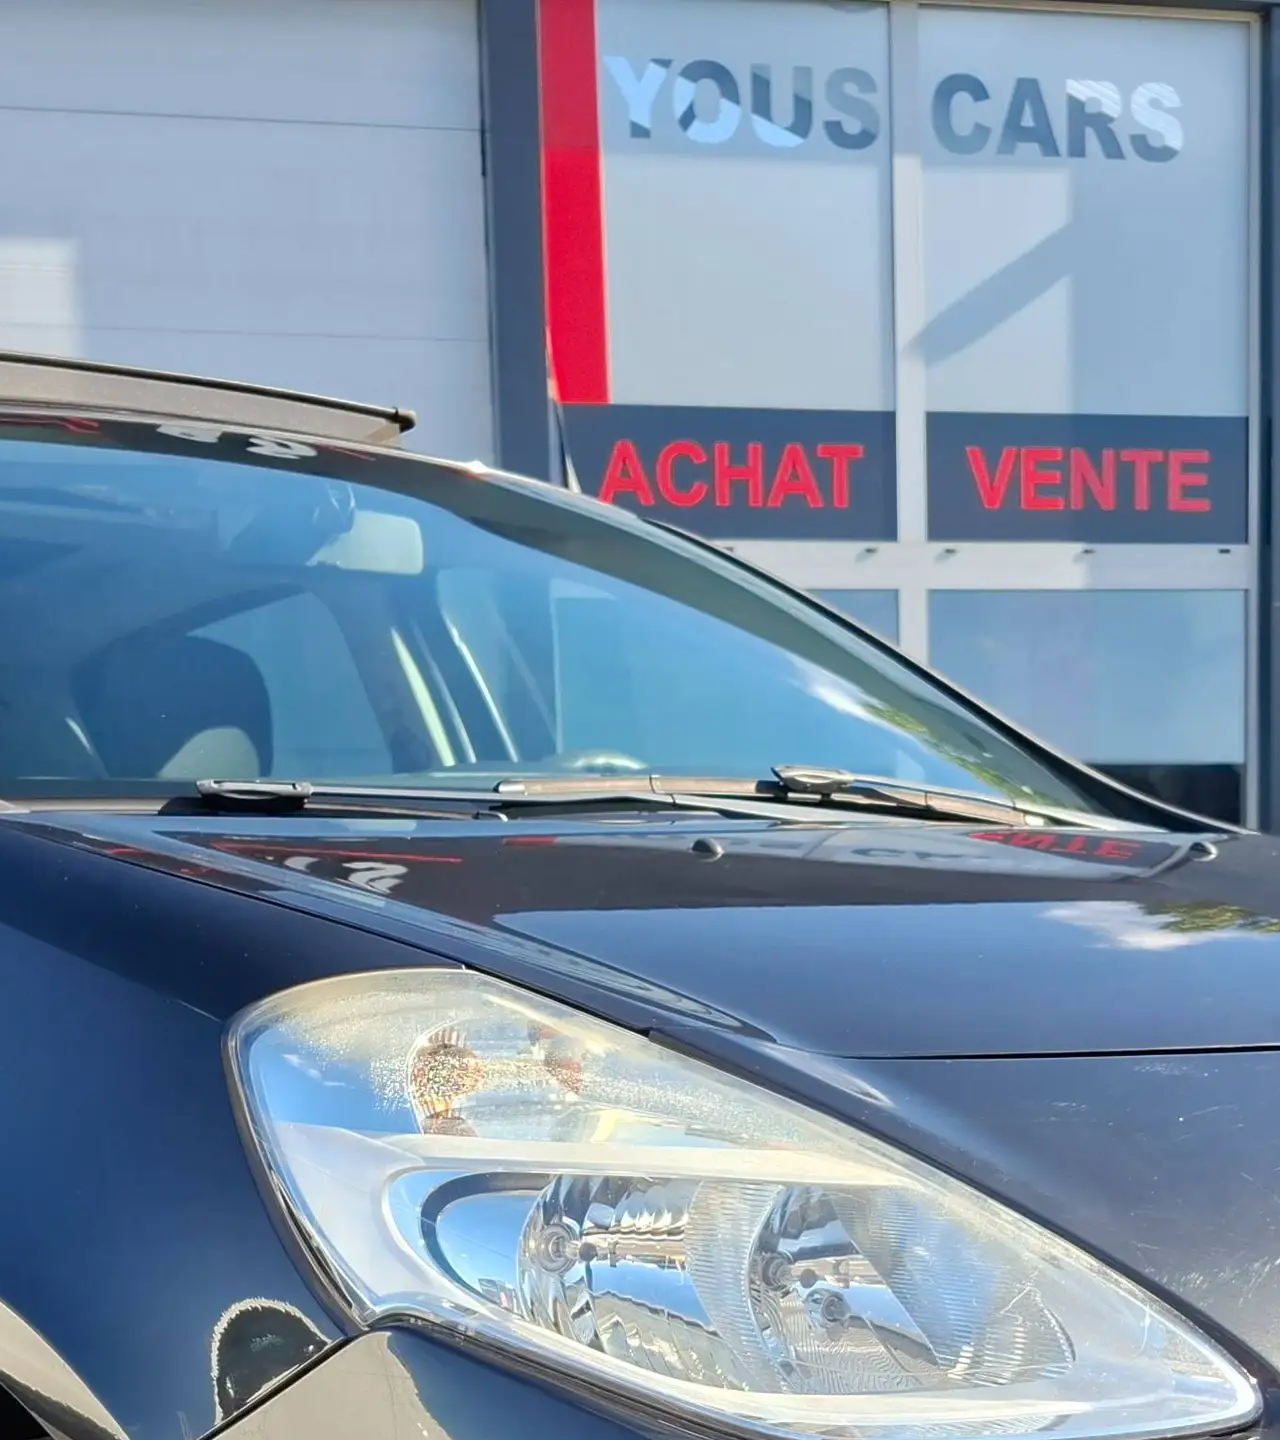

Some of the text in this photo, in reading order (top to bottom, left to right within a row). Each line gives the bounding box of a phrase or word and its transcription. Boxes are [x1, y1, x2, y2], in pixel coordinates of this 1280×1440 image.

[602, 55, 1183, 162] YOUS CARS
[599, 440, 865, 508] ACHAT
[966, 445, 1211, 513] VENTE
